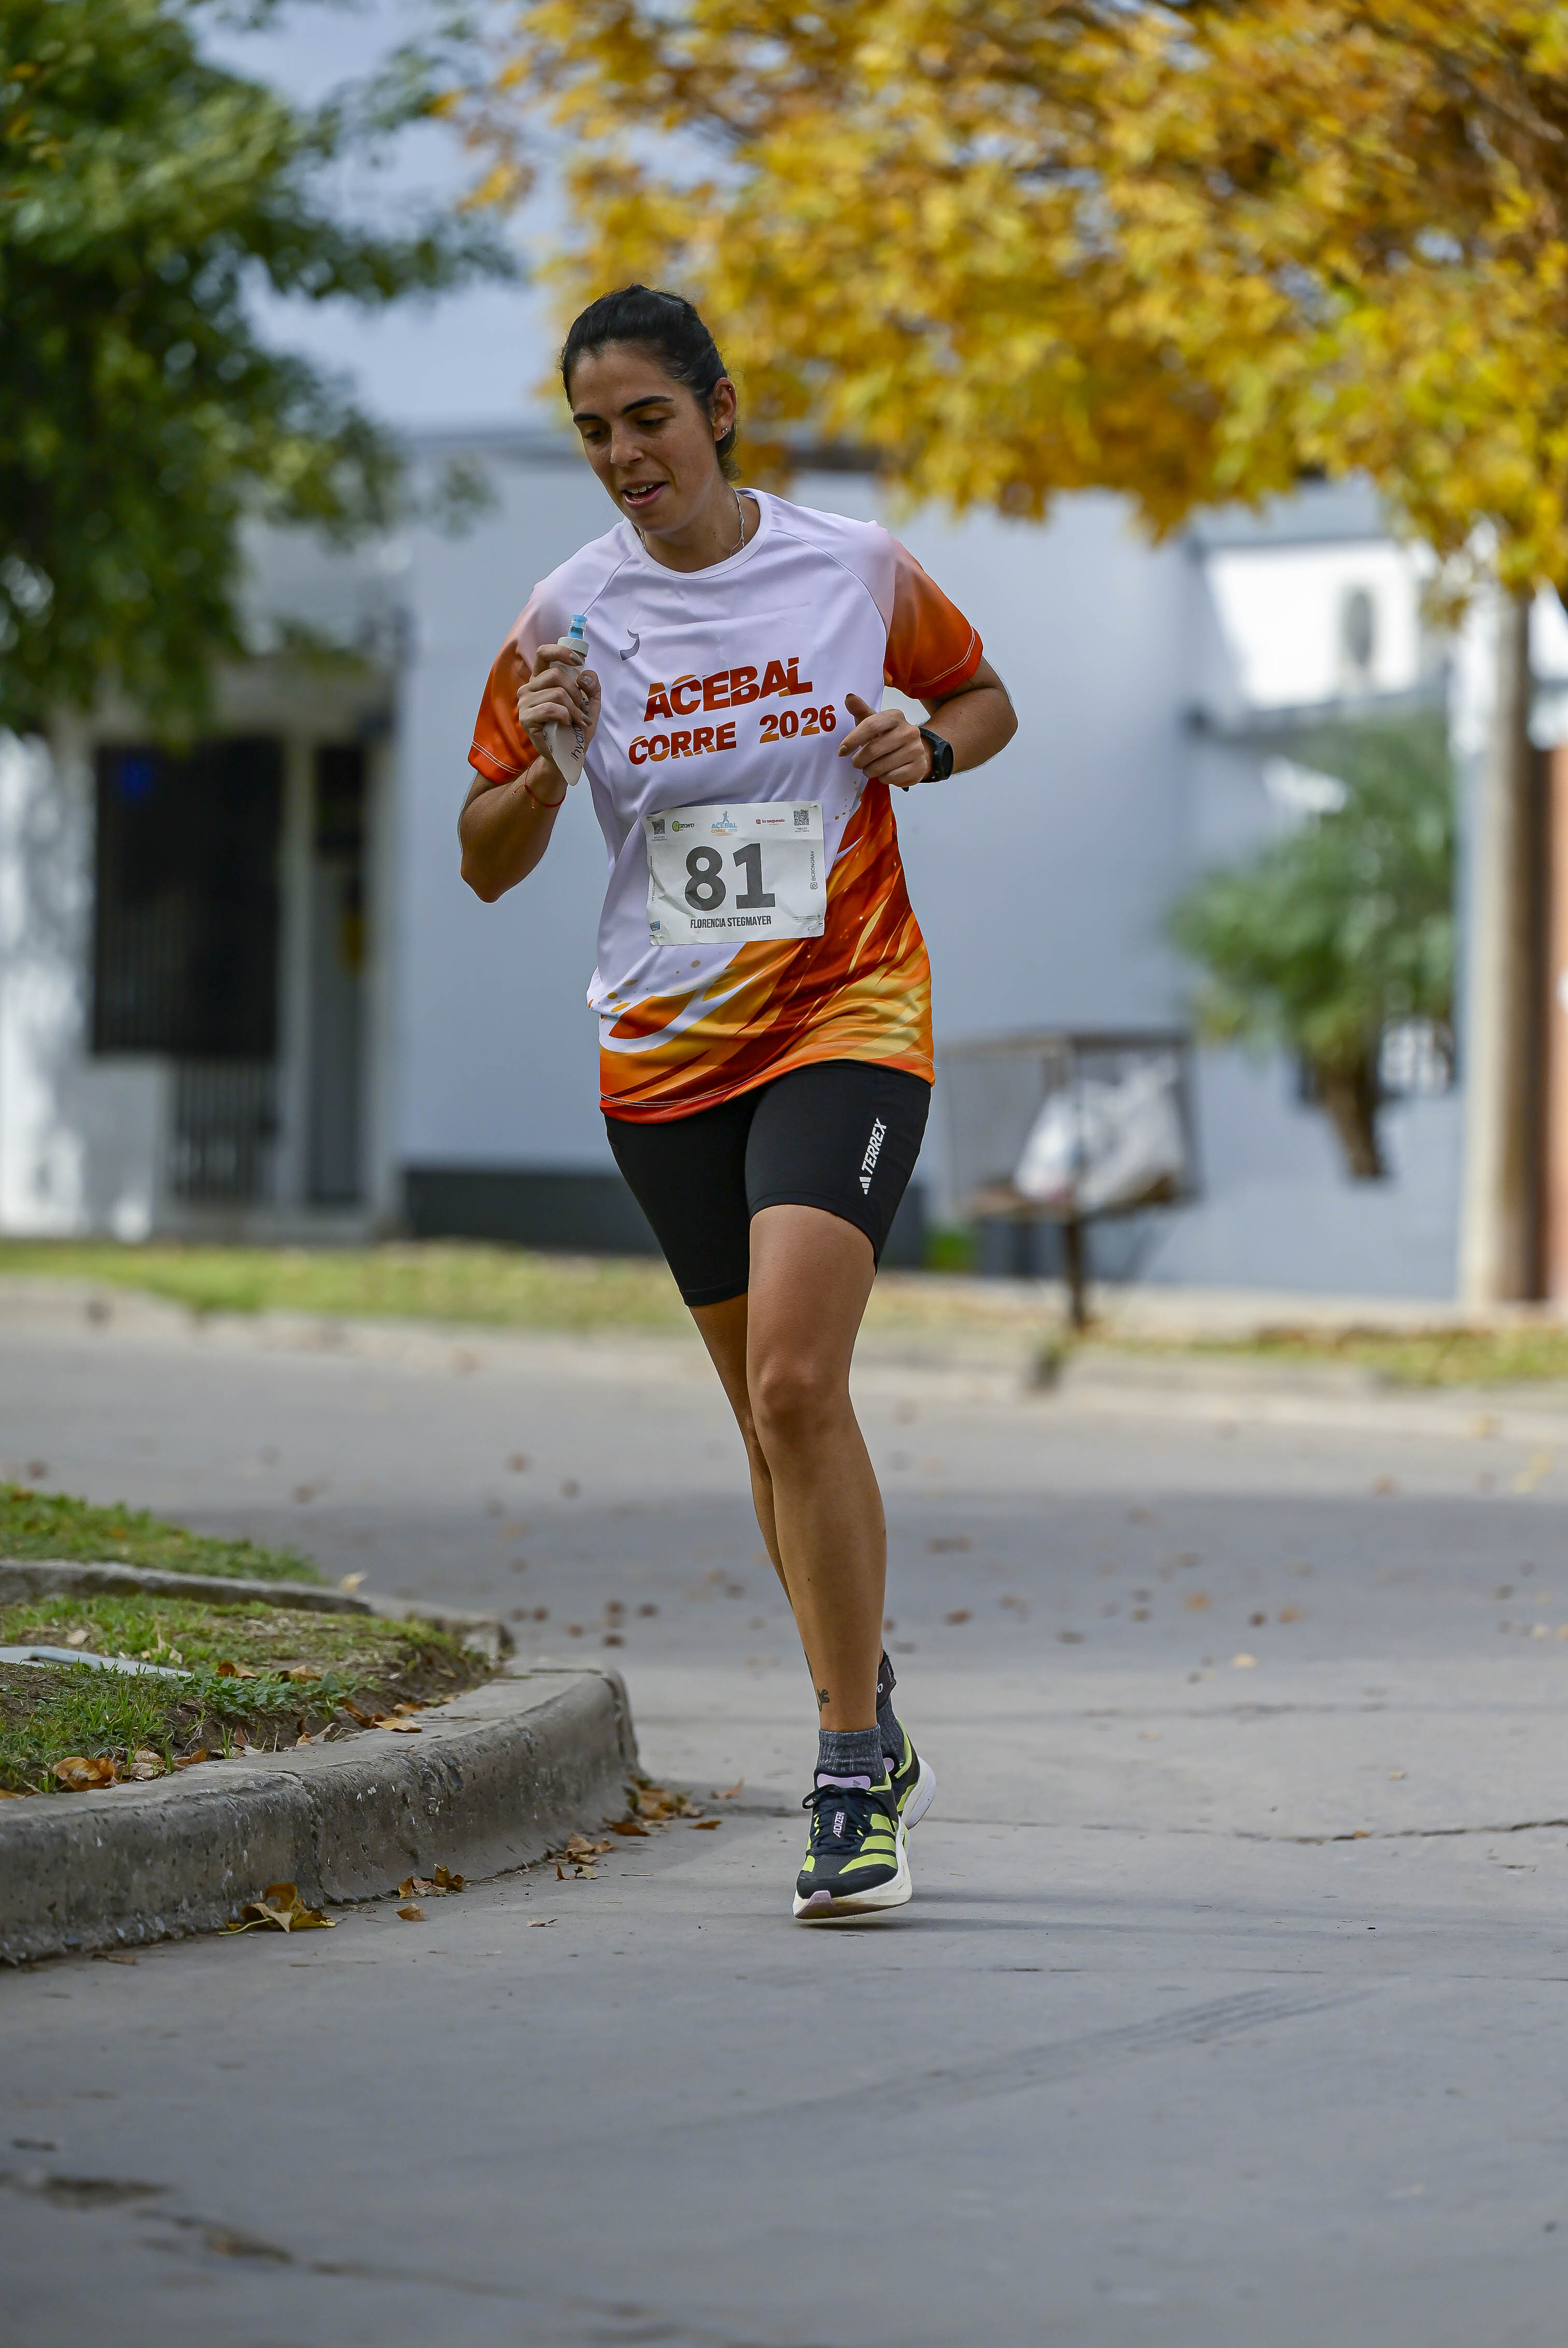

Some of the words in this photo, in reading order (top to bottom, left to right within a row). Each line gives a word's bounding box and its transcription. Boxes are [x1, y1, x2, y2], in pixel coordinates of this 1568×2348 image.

[643, 656, 813, 722] ACEBAL
[628, 721, 737, 765] CORRE
[759, 704, 836, 744] 2026
[684, 843, 776, 912] 81
[690, 918, 726, 929] FLORENCIA
[727, 915, 772, 927] STEGMAYER
[861, 1117, 887, 1175] TERREX
